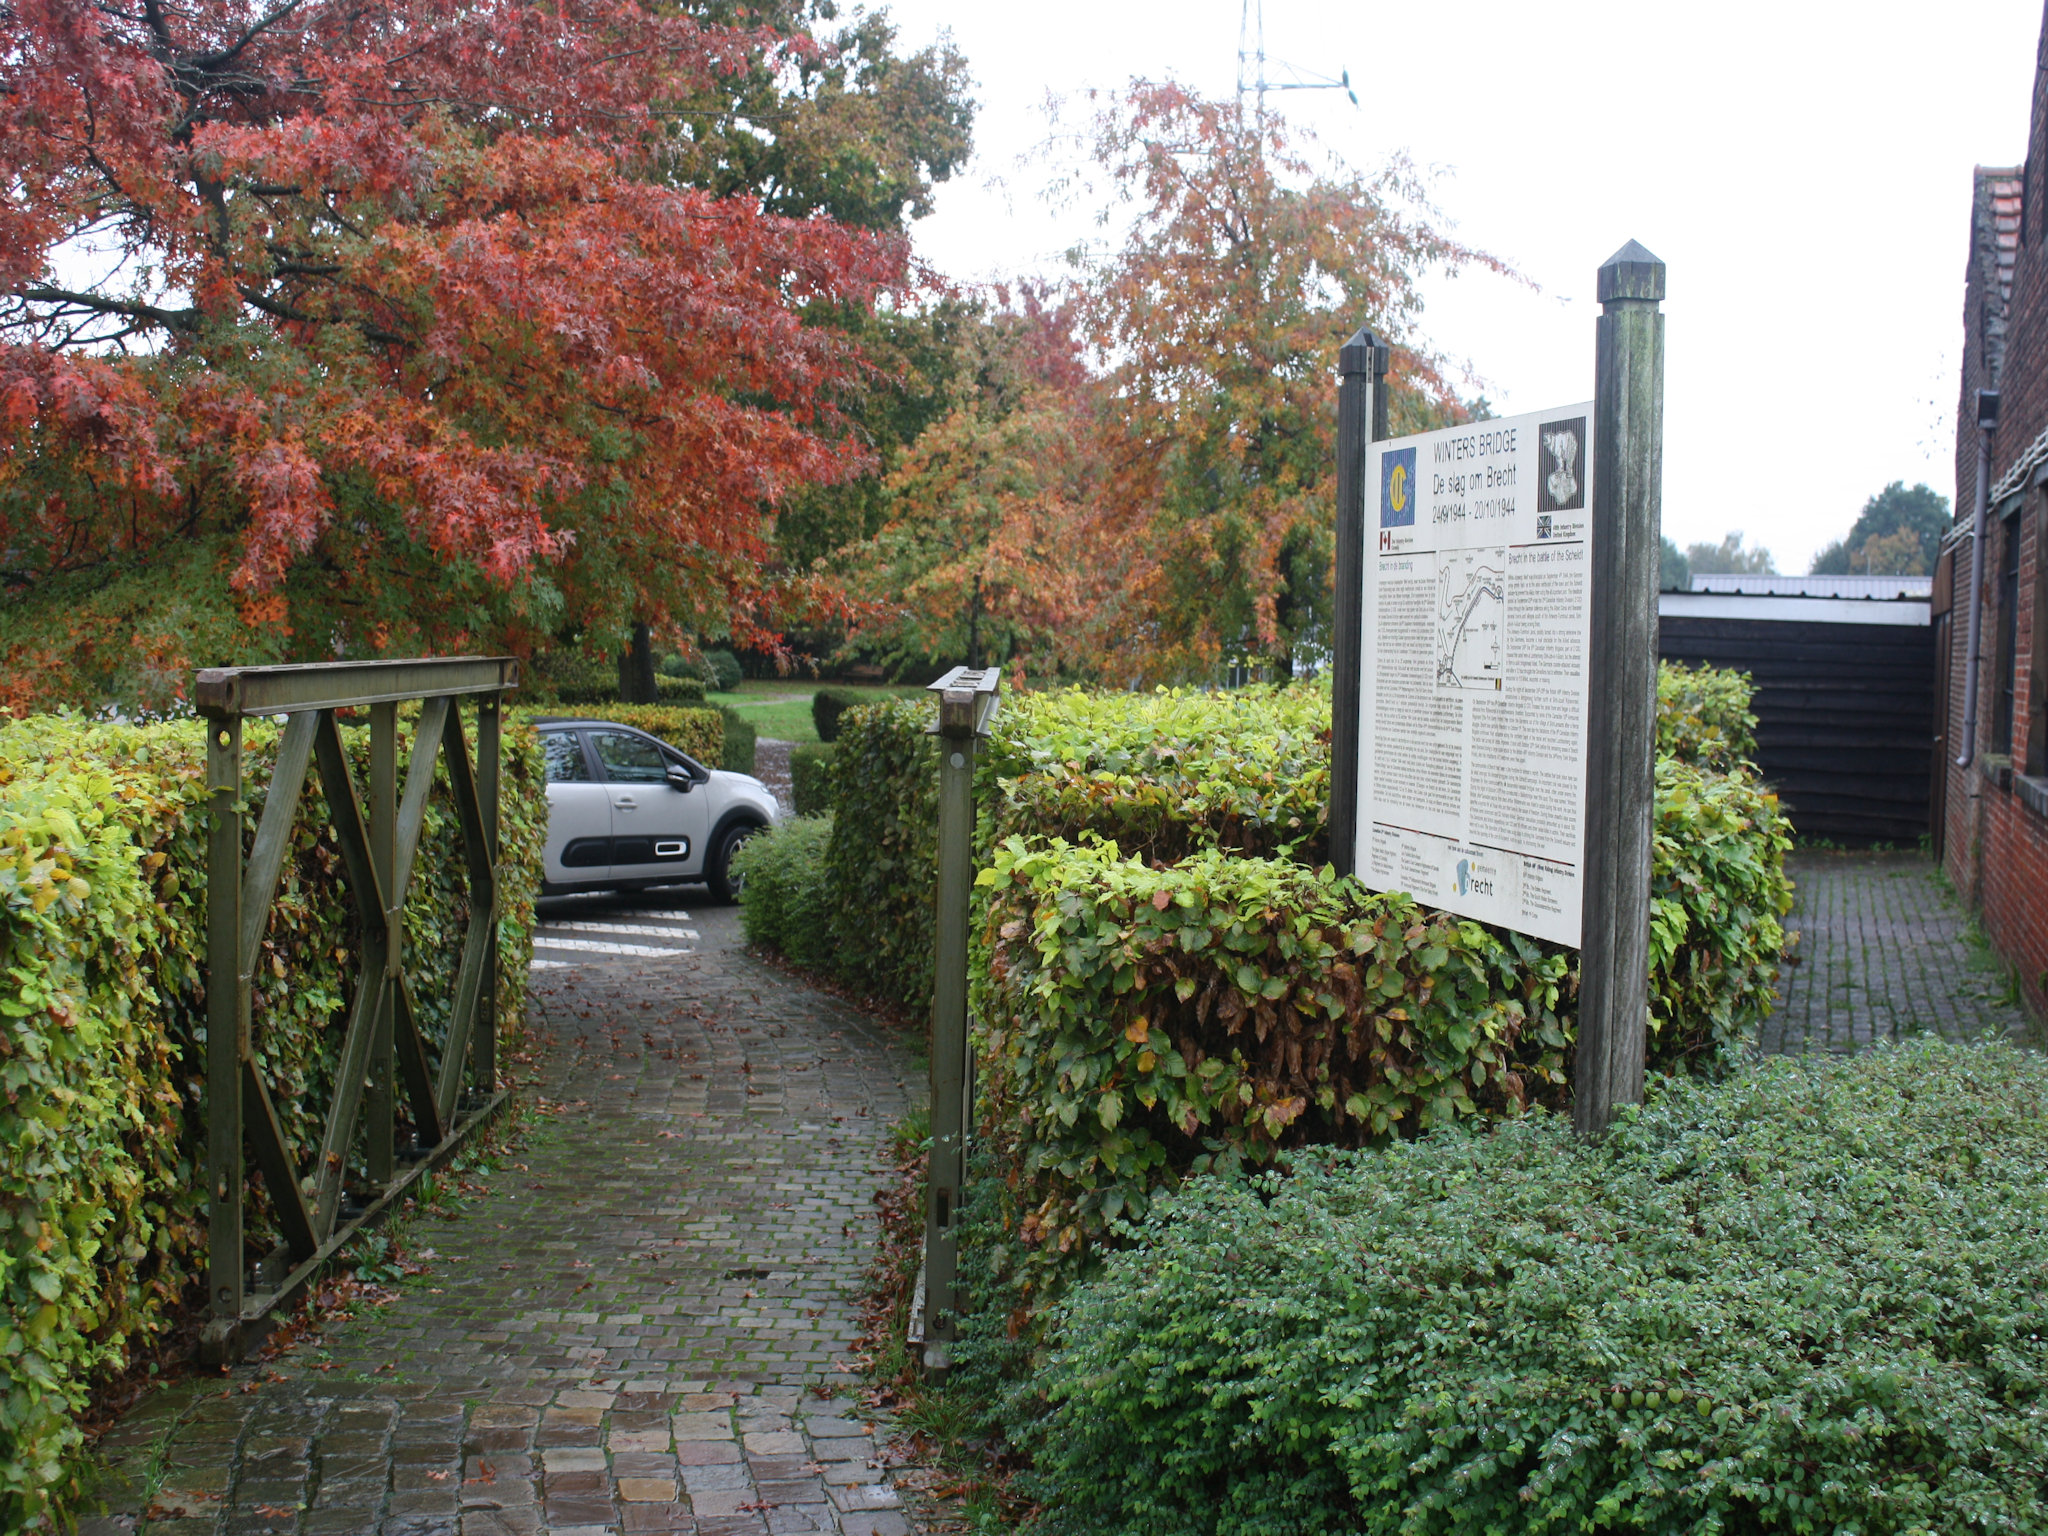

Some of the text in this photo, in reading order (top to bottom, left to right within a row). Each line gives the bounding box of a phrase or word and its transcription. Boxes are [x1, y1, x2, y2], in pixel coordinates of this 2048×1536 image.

[1433, 428, 1517, 463] WINTERS BRIDGE
[1433, 464, 1517, 497] De slag om Brecht
[1432, 503, 1466, 524] 24/9/1944
[1474, 497, 1516, 520] 20/10/1944
[1508, 552, 1523, 564] Brecht
